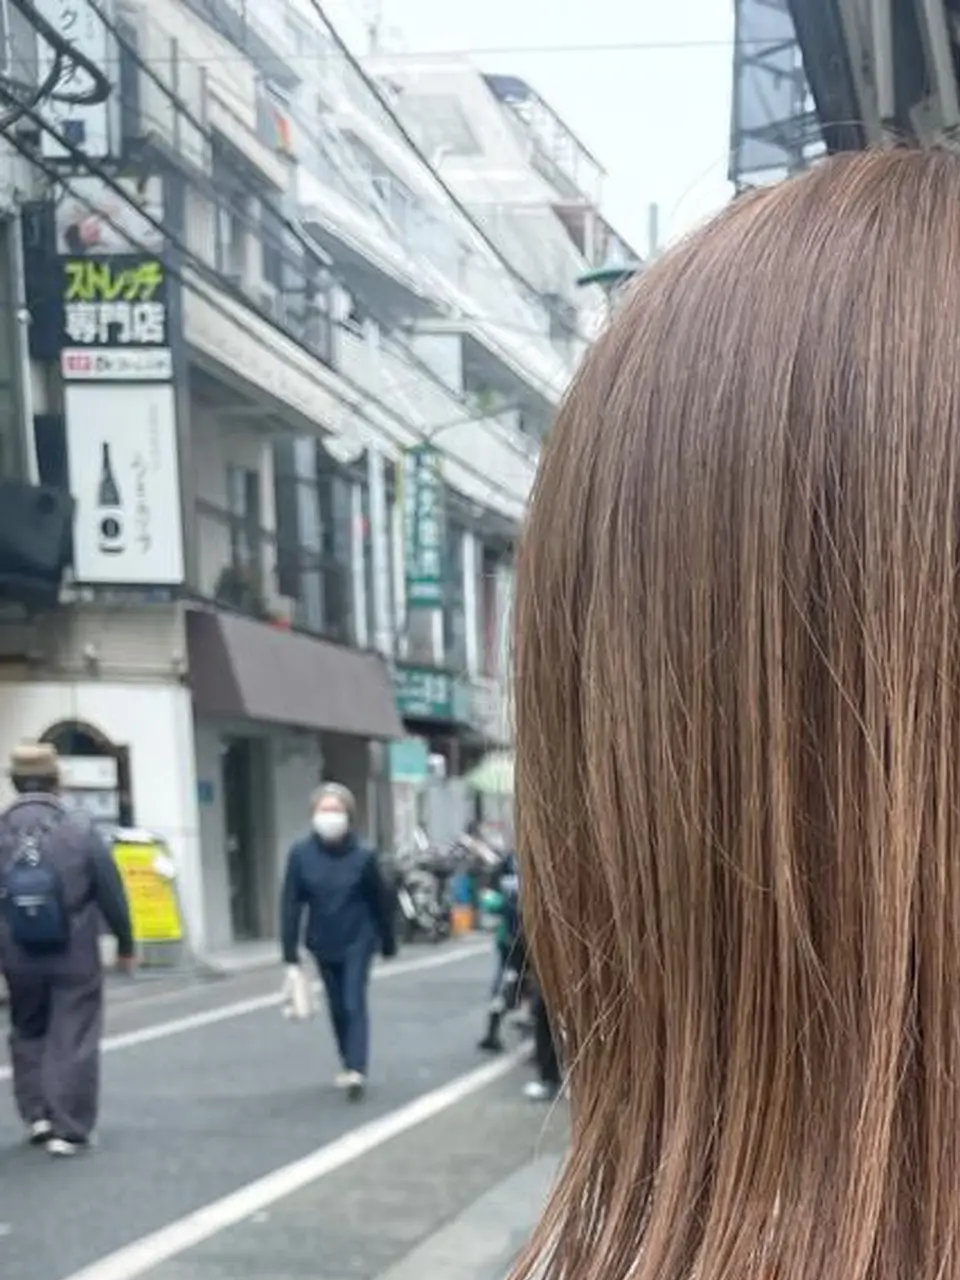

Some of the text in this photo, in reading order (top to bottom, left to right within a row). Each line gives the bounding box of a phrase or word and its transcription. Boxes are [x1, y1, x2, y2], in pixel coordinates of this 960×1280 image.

[64, 260, 163, 300] ストレッチ
[64, 301, 166, 343] 専門店
